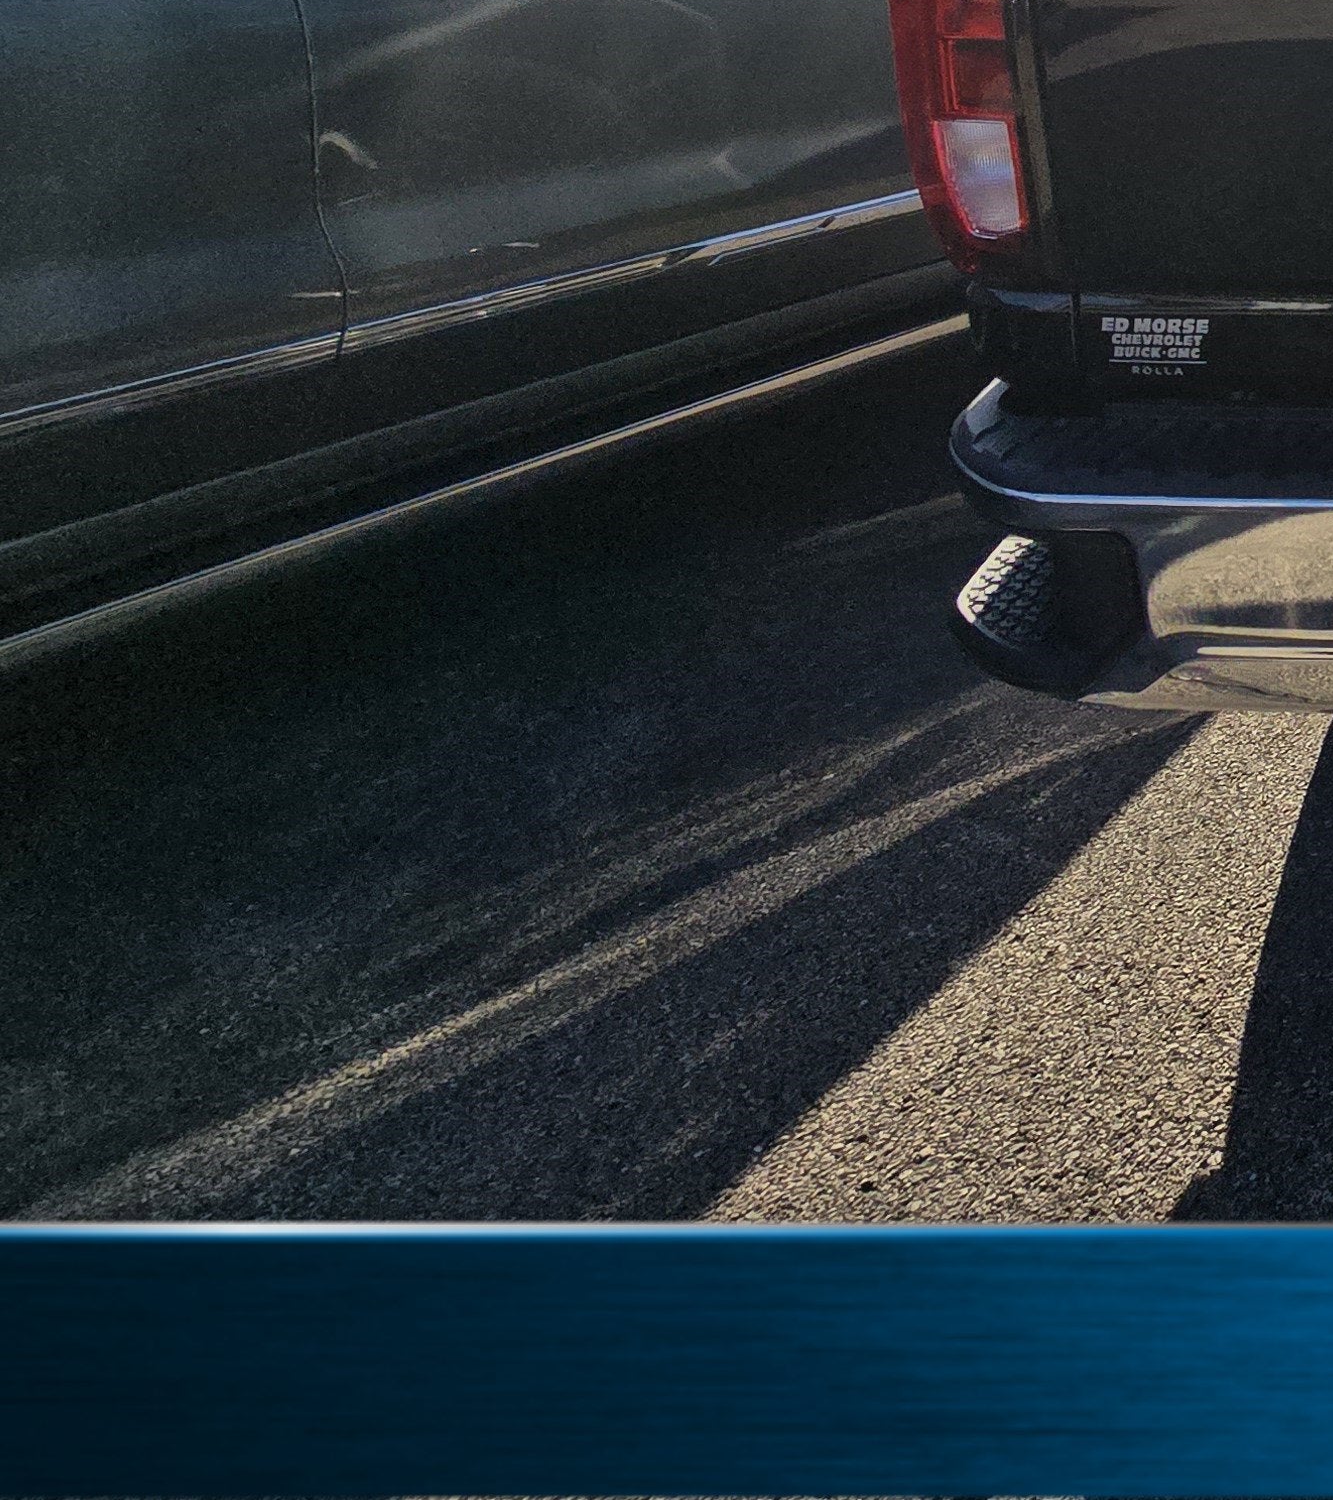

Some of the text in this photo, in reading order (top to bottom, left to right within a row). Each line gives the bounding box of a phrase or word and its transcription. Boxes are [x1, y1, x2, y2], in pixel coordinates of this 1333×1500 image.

[1101, 316, 1210, 334] ED MORSE
[1111, 333, 1204, 347] CHEVROLET
[1131, 365, 1184, 376] ROLLA
